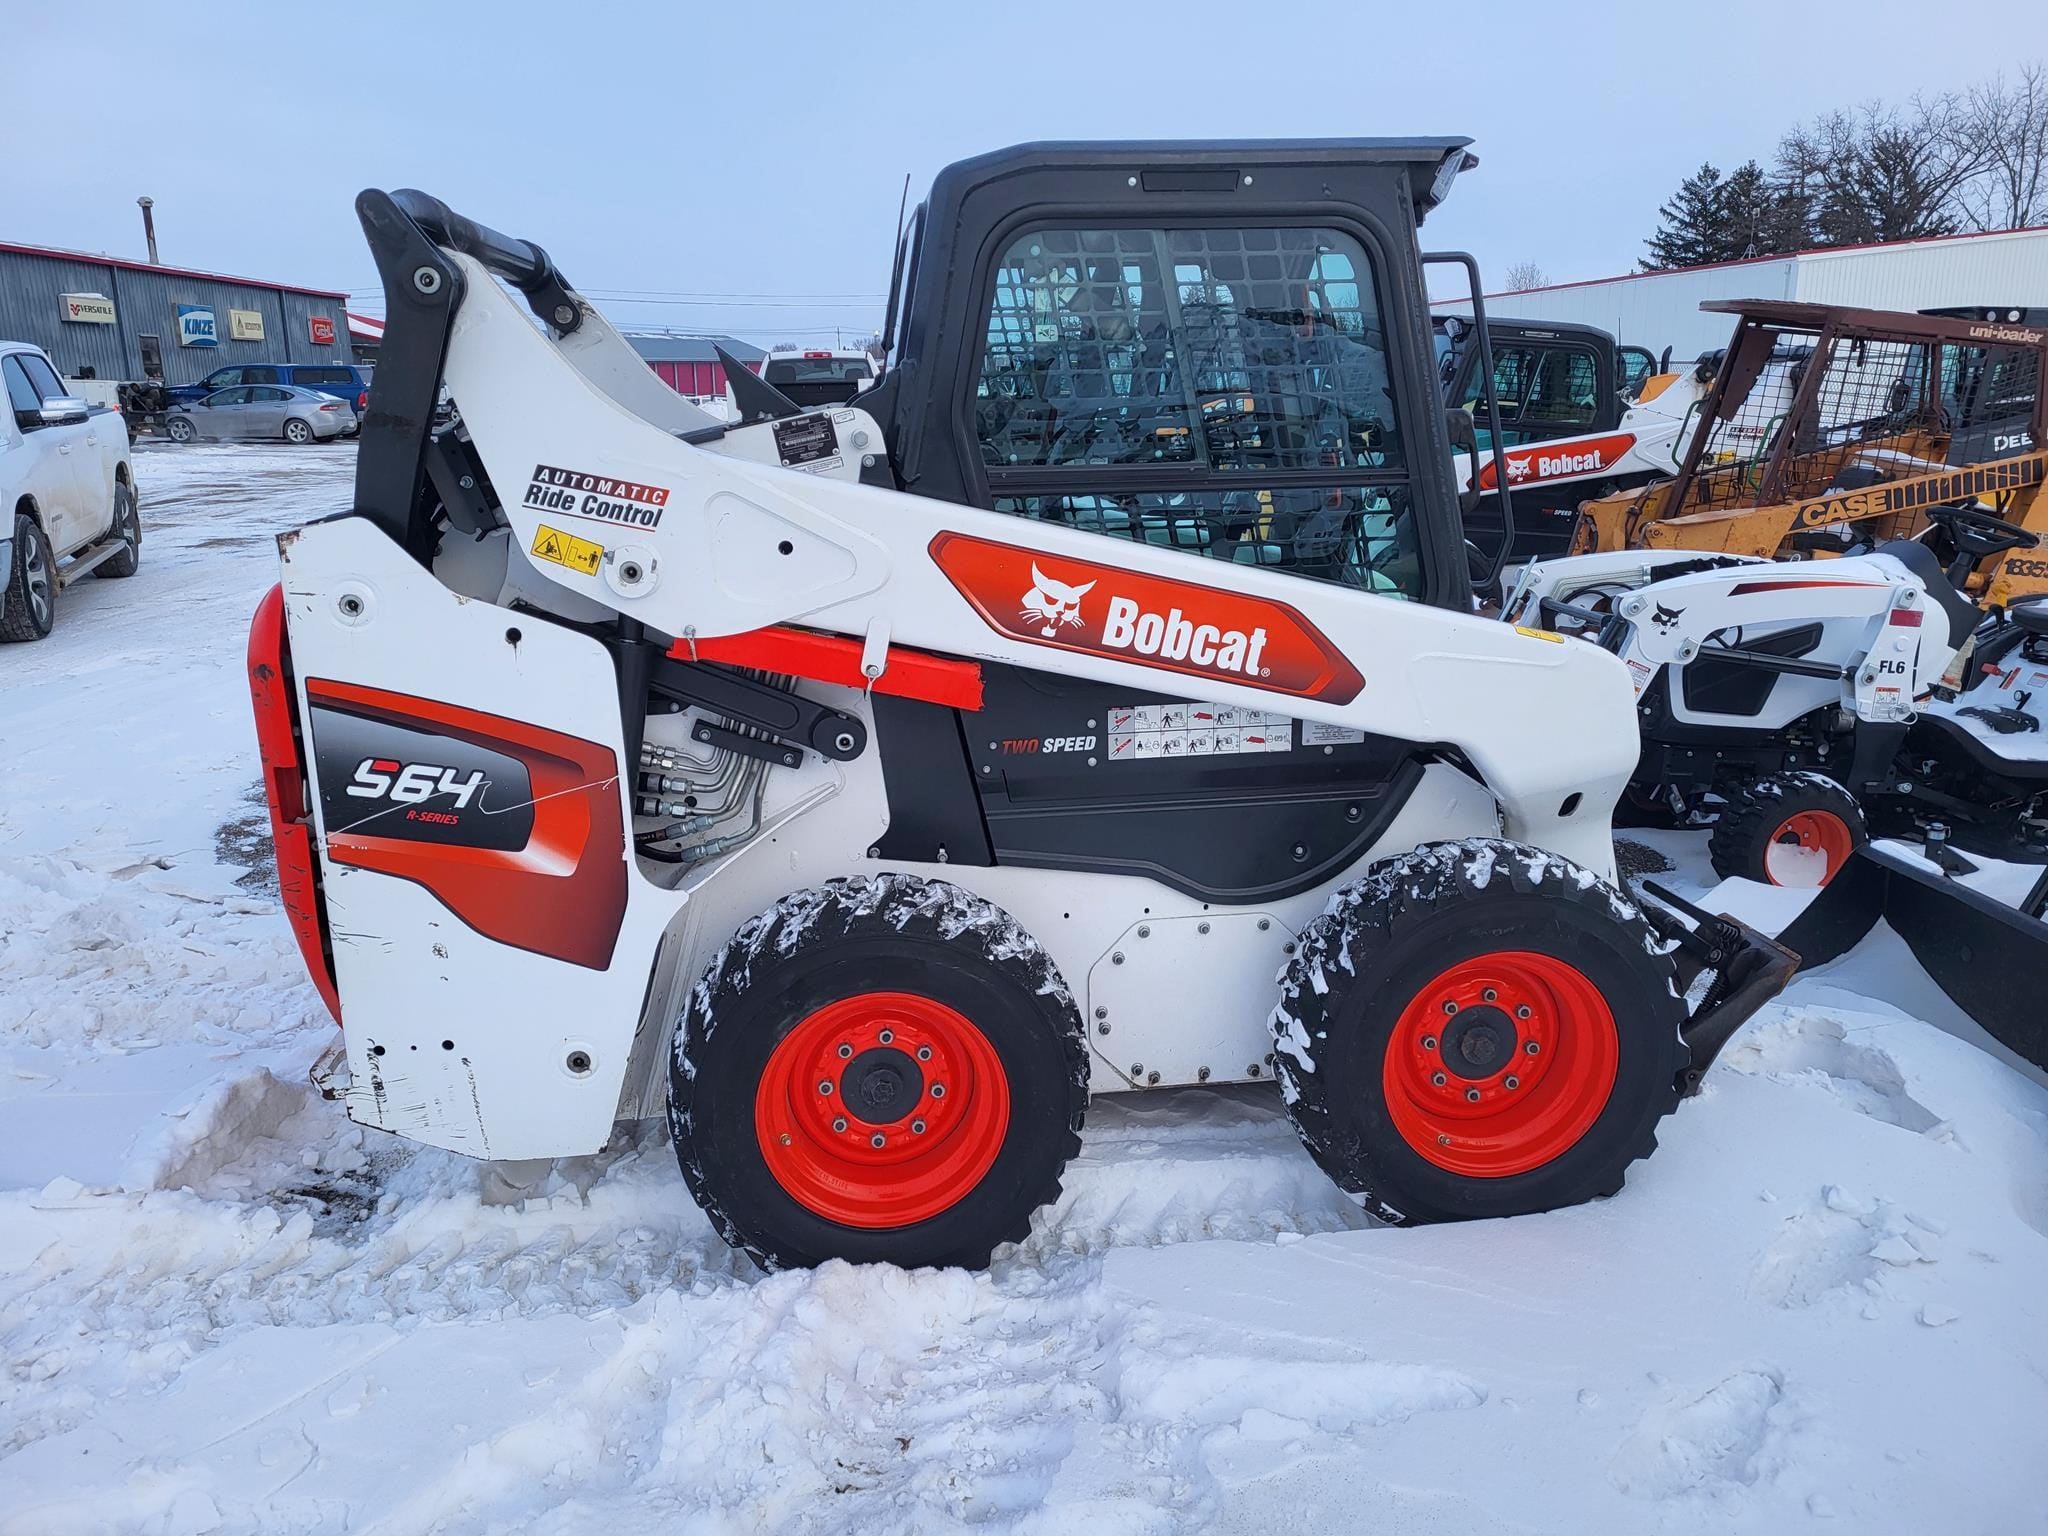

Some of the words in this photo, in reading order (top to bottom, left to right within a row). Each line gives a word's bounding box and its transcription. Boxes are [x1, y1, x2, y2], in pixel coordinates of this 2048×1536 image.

[184, 318, 214, 336] KINZE
[1538, 449, 1601, 477] Bobcat
[538, 467, 665, 505] AUTOMATIC
[523, 483, 576, 512] Ride
[580, 494, 664, 528] Control
[1801, 490, 1888, 526] CASE
[1101, 595, 1271, 677] Bobcat
[1878, 660, 1906, 674] FL6
[1002, 738, 1040, 754] TWO
[1042, 735, 1097, 753] SPEED
[346, 757, 488, 810] S64
[405, 809, 460, 826] R-SERIES
